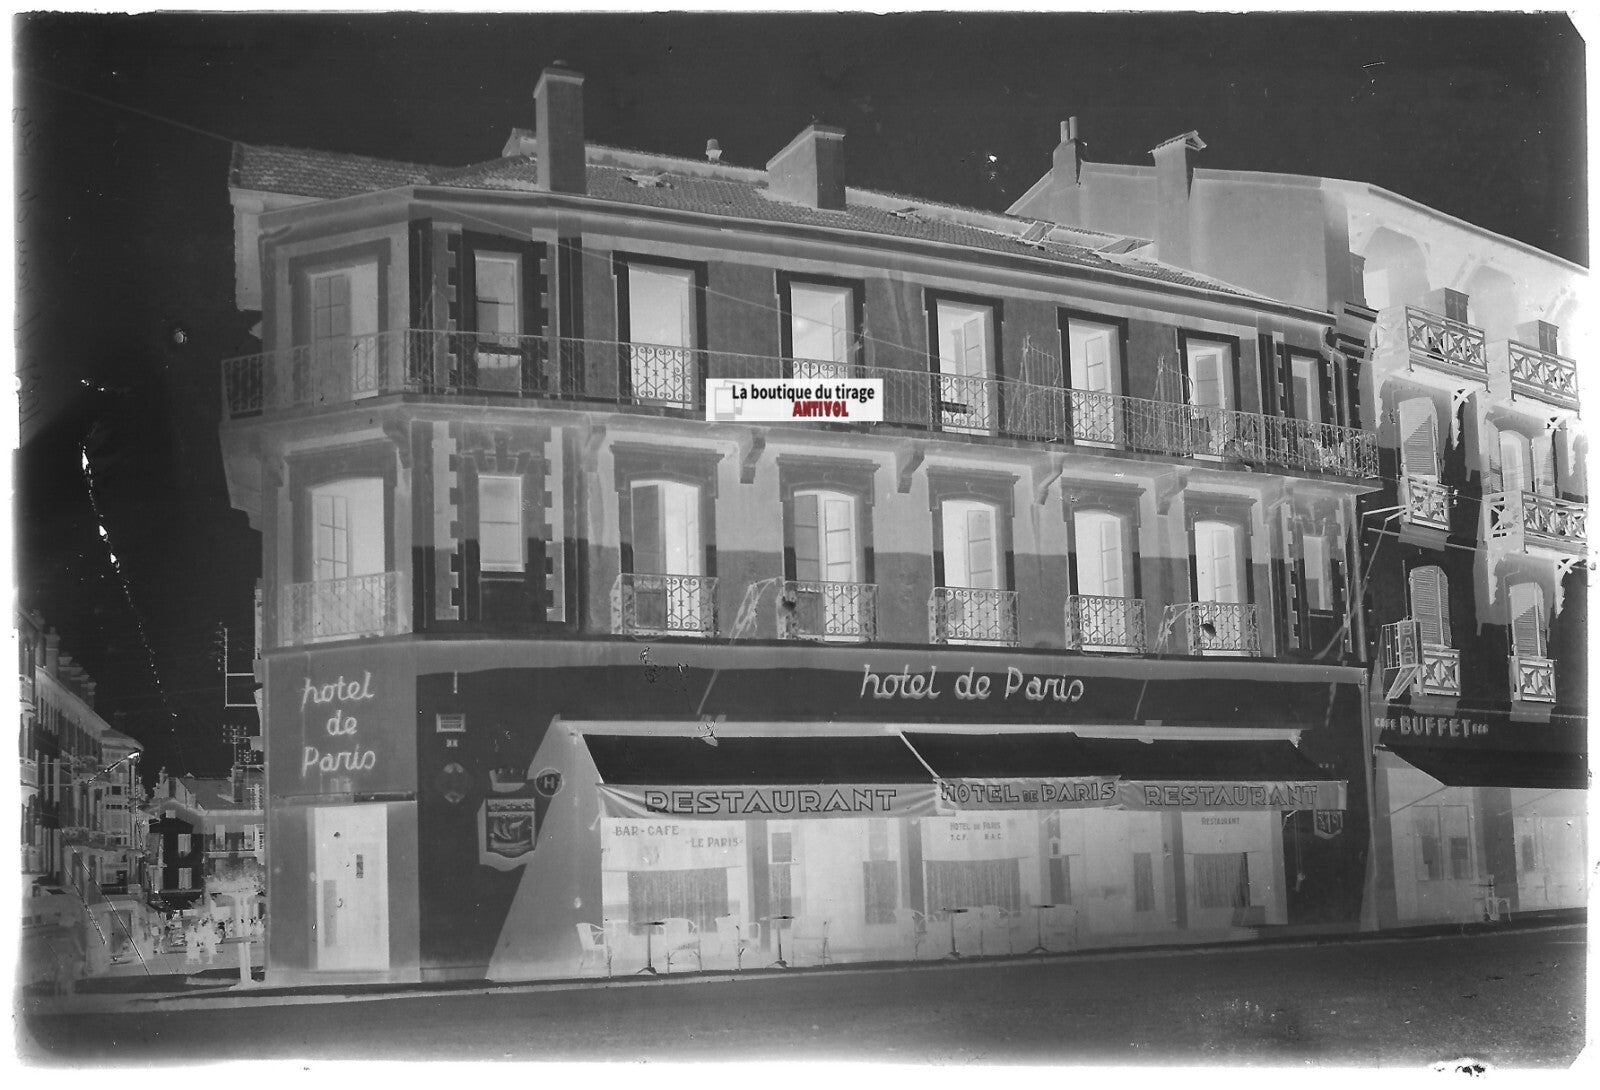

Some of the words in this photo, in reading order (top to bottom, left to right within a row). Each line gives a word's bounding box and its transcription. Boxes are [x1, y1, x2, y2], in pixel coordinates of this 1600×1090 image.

[1402, 623, 1414, 664] BAR
[301, 670, 375, 712] hotel
[859, 664, 941, 699] hotel
[955, 667, 991, 699] de
[1005, 667, 1084, 701] Paris
[327, 709, 357, 736] de
[1400, 716, 1470, 738] BUFFET
[302, 744, 376, 777] Paris
[644, 789, 897, 814] RESTAURANT
[940, 784, 1020, 803] HOTEL
[1041, 782, 1116, 802] PARIS
[1143, 785, 1317, 806] RESTAURANT
